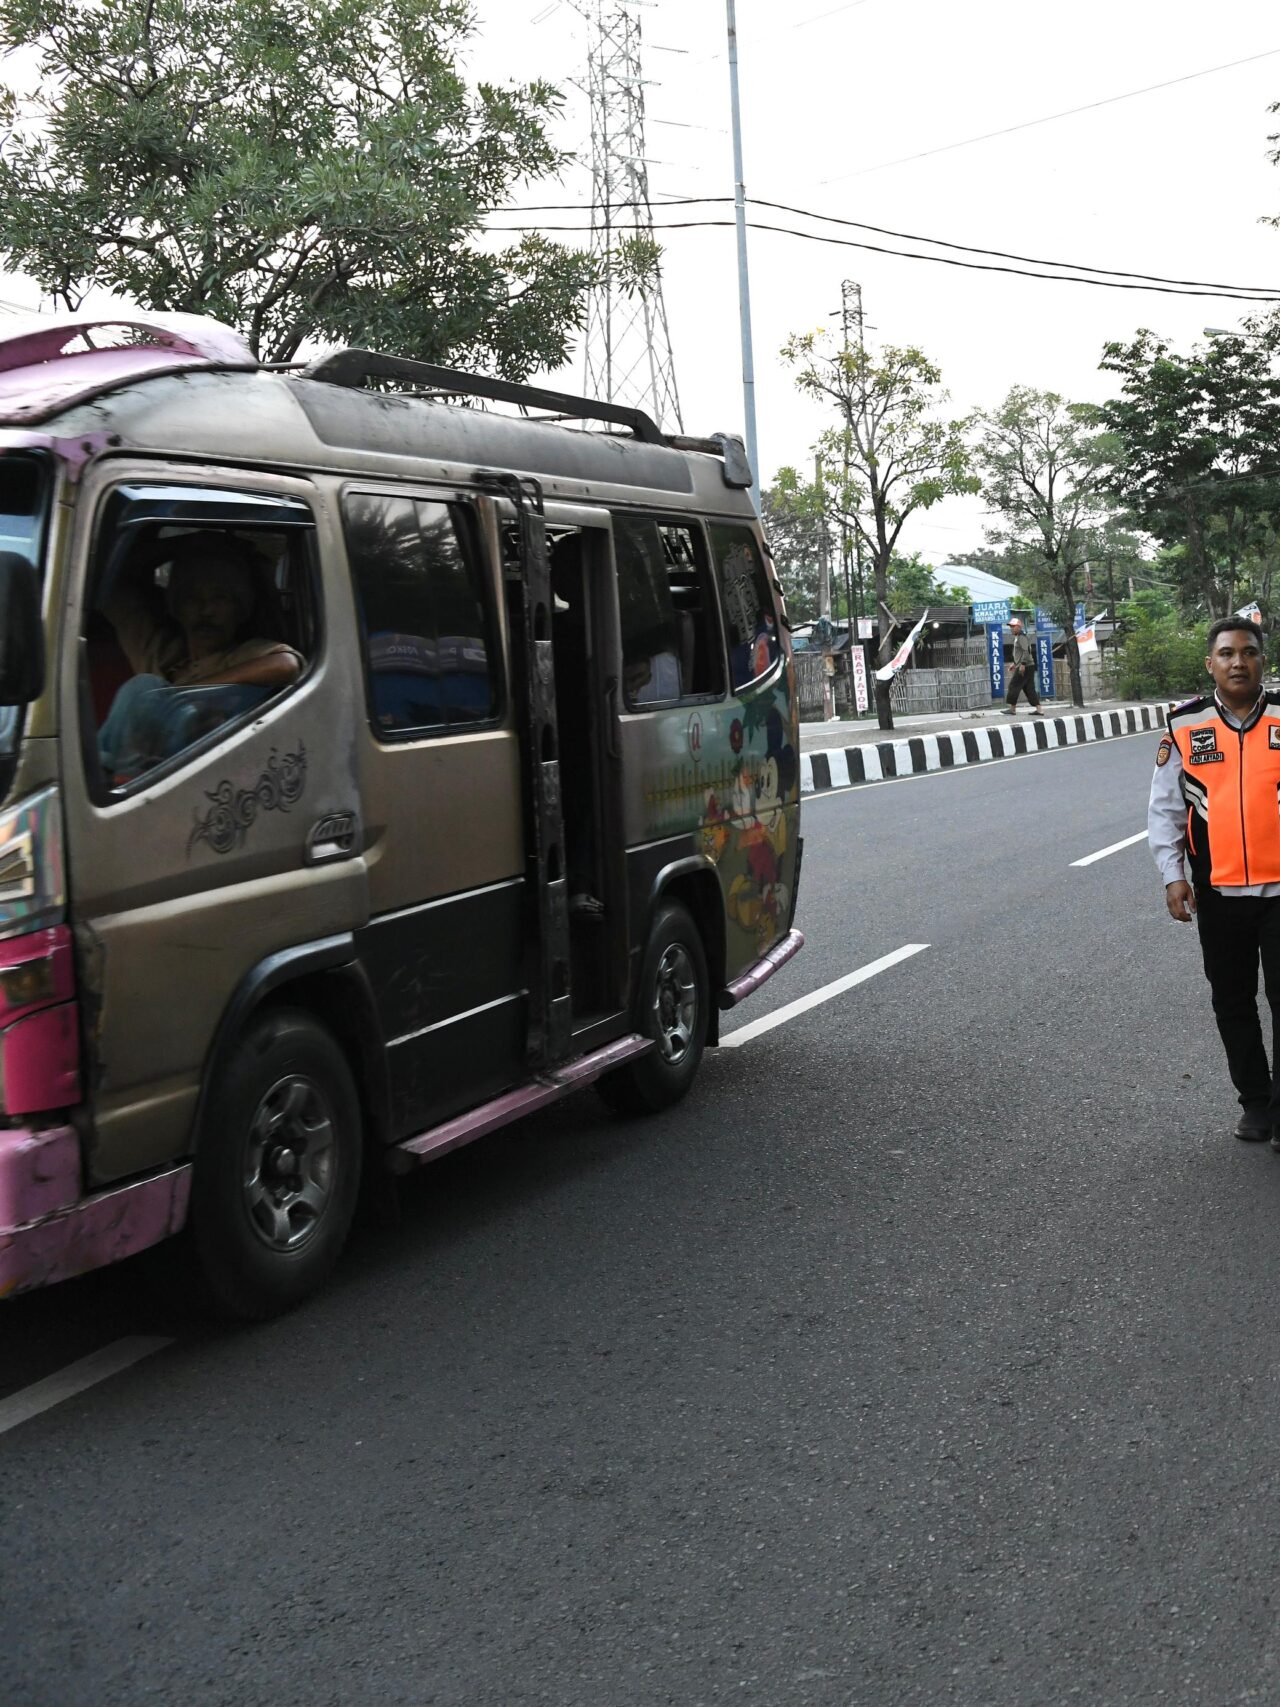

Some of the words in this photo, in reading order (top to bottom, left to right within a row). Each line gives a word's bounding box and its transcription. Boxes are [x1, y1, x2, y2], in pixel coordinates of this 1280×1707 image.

[974, 602, 1008, 612] JUARA
[854, 654, 866, 709] RADIATOR
[991, 631, 1001, 690] KNALPOT
[1040, 640, 1050, 693] KNALPOT
[1192, 741, 1215, 752] CORPS
